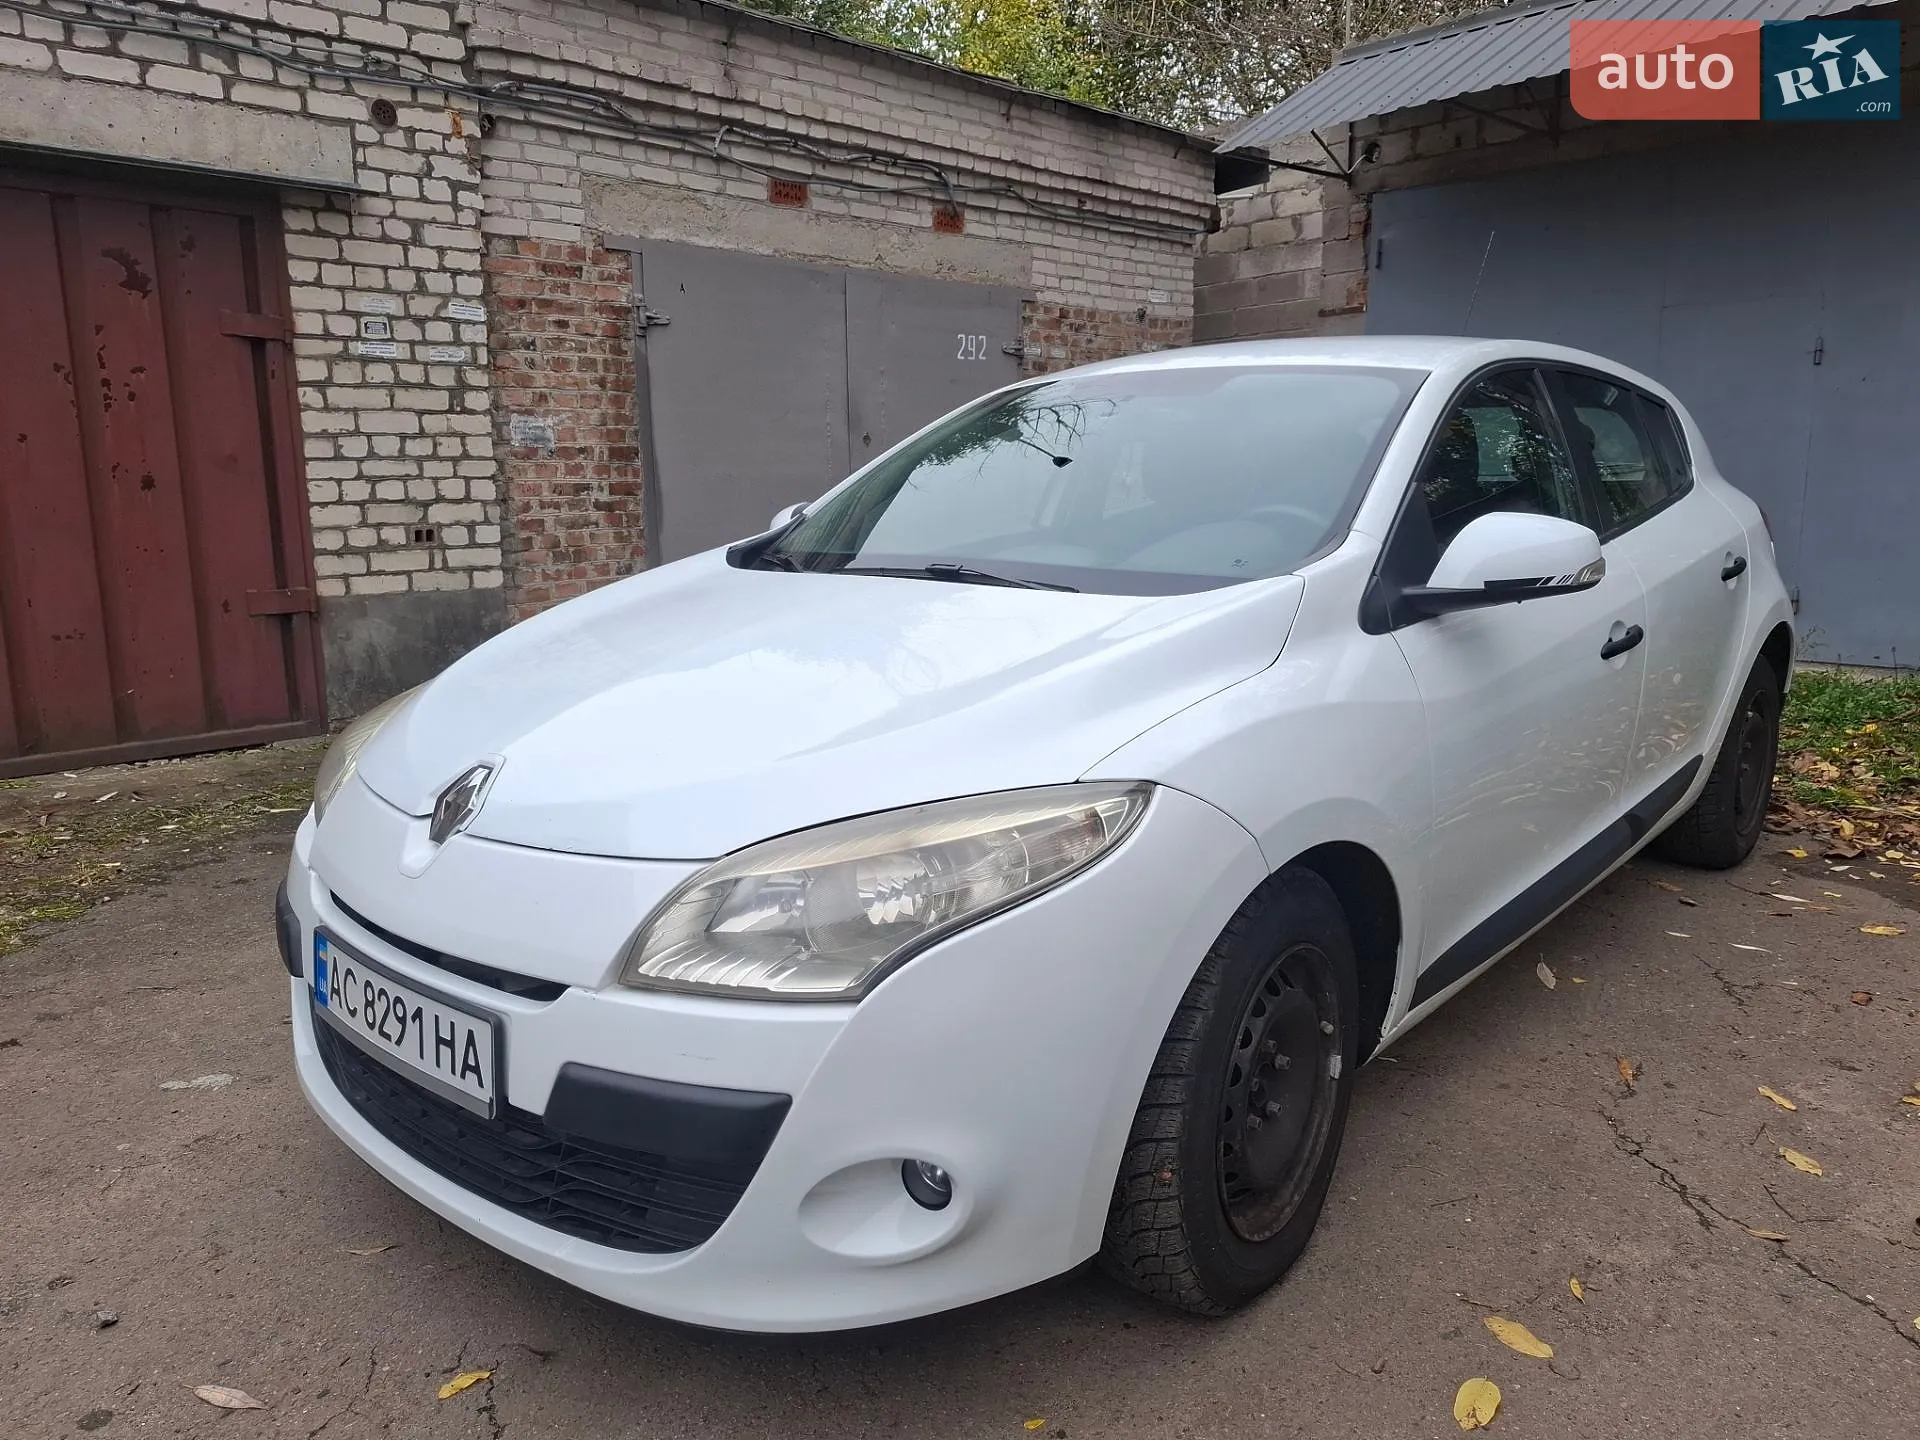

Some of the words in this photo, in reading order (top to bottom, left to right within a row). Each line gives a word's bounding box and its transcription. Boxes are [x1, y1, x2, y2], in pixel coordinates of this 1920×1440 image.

[957, 334, 986, 360] 292
[330, 956, 358, 1018] AC
[363, 979, 425, 1061] 8291
[434, 1013, 485, 1089] HA
